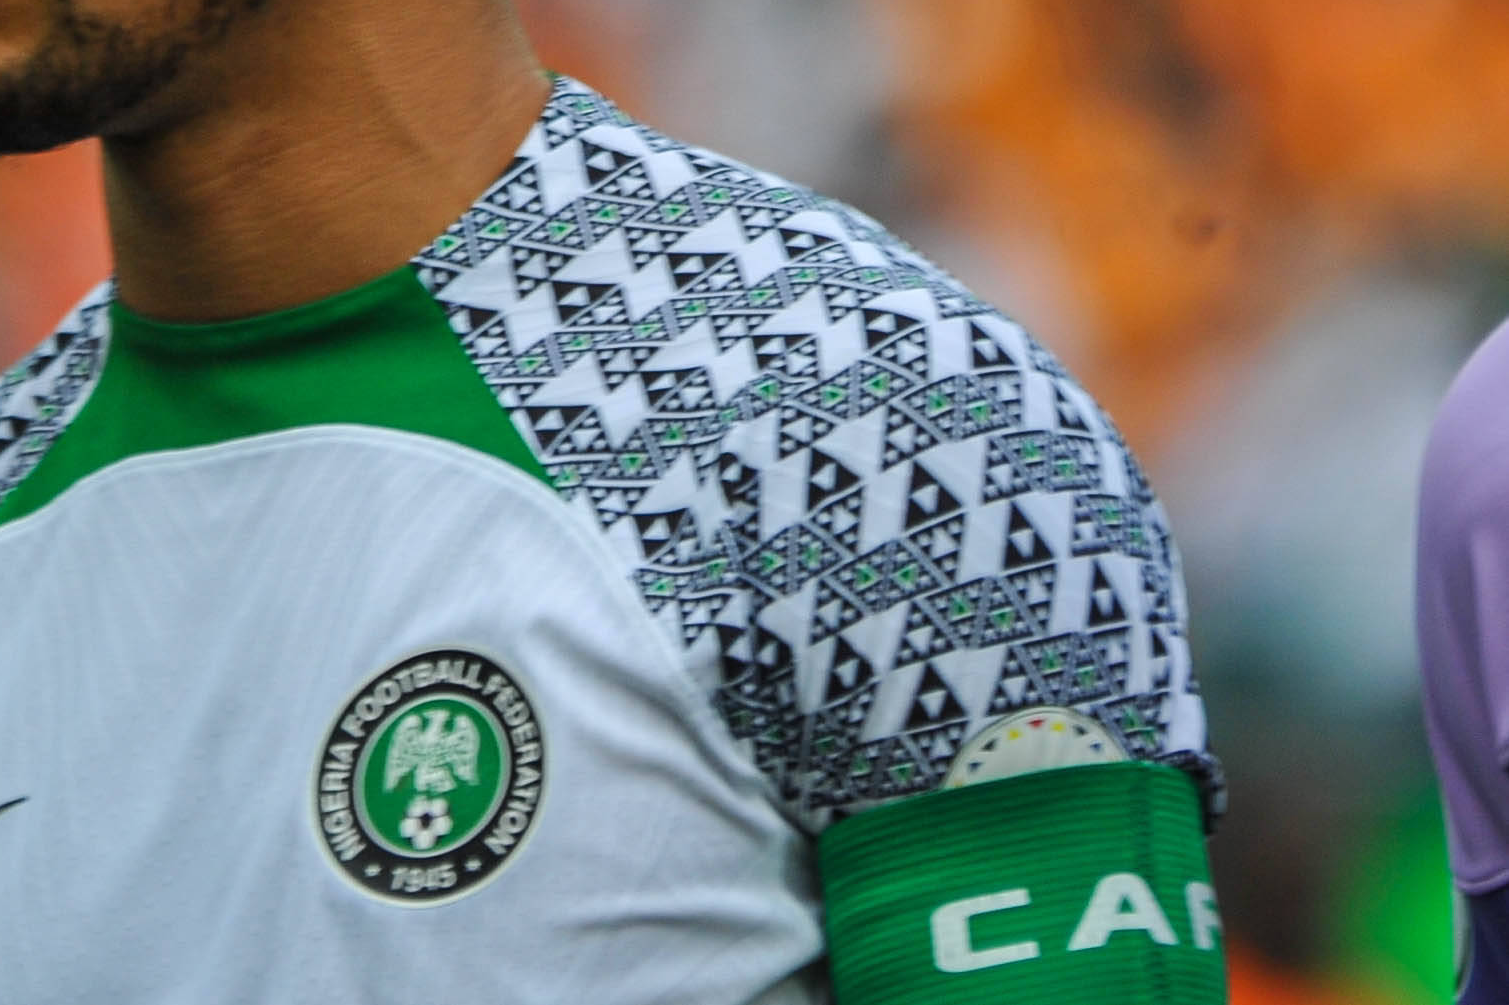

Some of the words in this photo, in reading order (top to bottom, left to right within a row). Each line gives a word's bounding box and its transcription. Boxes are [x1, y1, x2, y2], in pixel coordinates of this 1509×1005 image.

[340, 659, 483, 738] FOOTBALL
[319, 741, 368, 862] NIGERIA
[481, 673, 542, 855] FEDERATION
